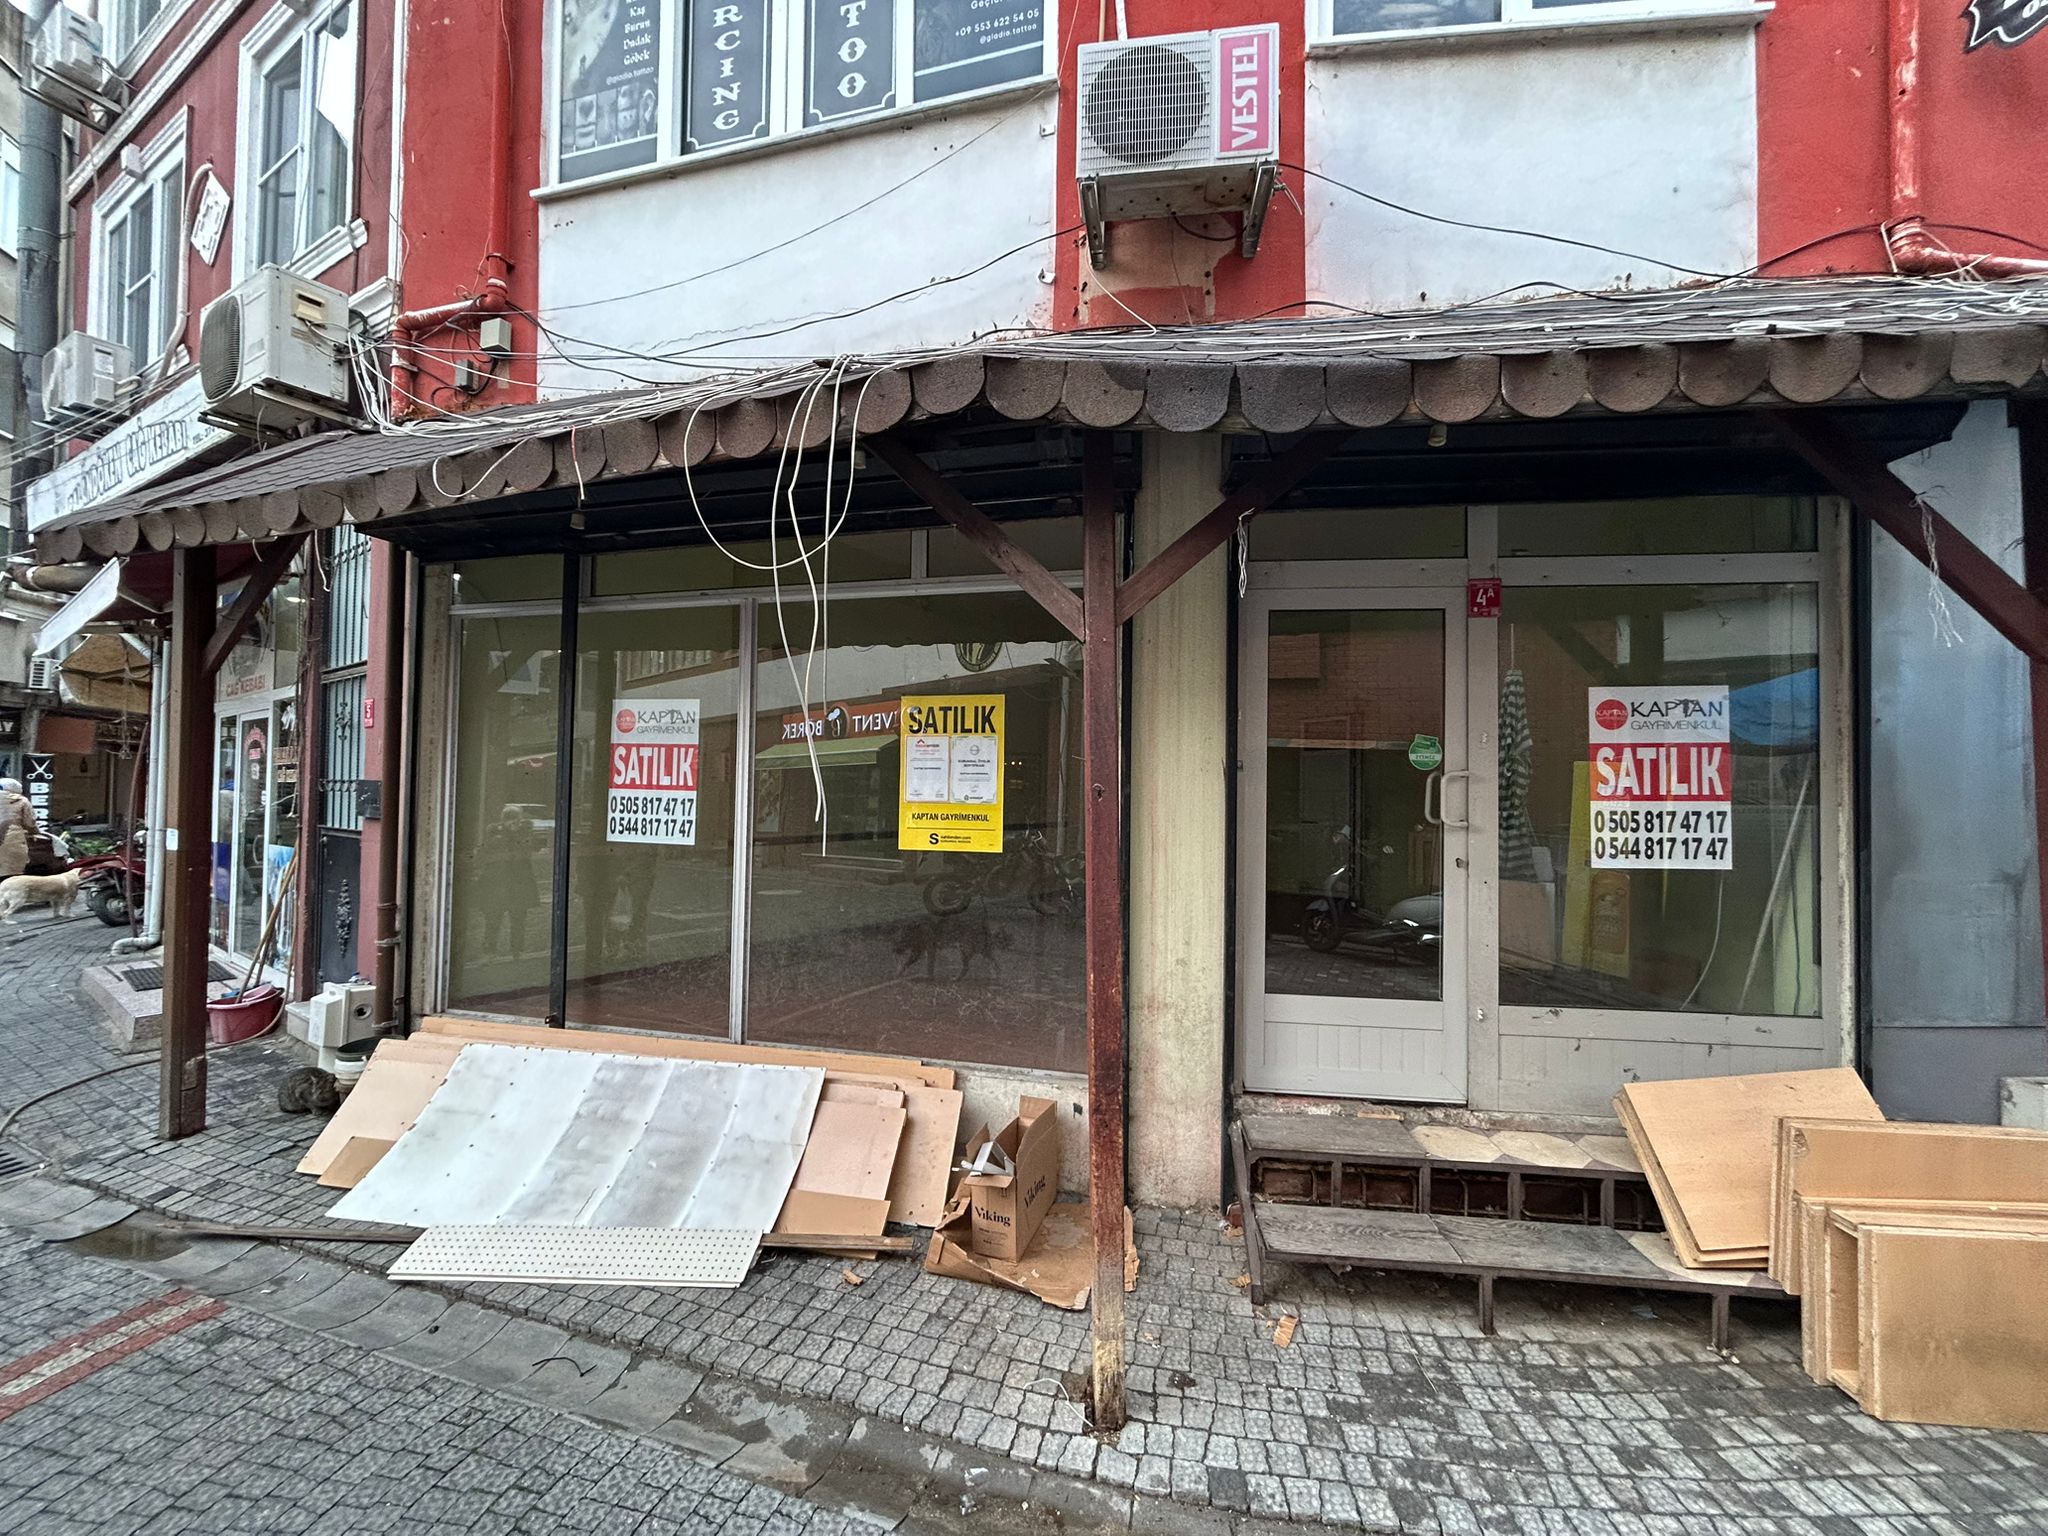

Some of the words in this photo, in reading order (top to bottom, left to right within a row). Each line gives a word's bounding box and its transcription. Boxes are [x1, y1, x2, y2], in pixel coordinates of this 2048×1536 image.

[624, 19, 650, 33] Burun
[974, 20, 991, 33] 553
[993, 16, 1010, 28] 622
[1012, 12, 1024, 23] 54
[1026, 8, 1039, 18] 05
[623, 33, 651, 49] Dudak
[980, 24, 1037, 44] @gladio.tattoo
[1231, 37, 1258, 149] VESTEL
[638, 708, 696, 725] KAPTAN
[1630, 699, 1723, 718] KAPTAN
[907, 705, 997, 734] SATILIK
[613, 746, 695, 787] SATILIK
[1596, 746, 1724, 796] SATILIK
[610, 796, 618, 814] 0
[619, 796, 640, 815] 505
[641, 797, 662, 816] 817
[664, 797, 678, 816] 47
[680, 798, 695, 817] 17
[912, 812, 939, 821] KAPTAN
[940, 812, 990, 822] GAYRİMENKUL
[609, 816, 617, 835] 0
[618, 816, 639, 835] 544
[640, 817, 661, 836] 817
[664, 818, 677, 837] 17
[679, 819, 693, 838] 47
[1594, 810, 1605, 833] 0
[1608, 810, 1640, 833] 505
[1644, 810, 1677, 833] 817
[1680, 810, 1702, 833] 47
[1705, 811, 1728, 833] 17
[1594, 836, 1606, 859] 0
[1608, 836, 1640, 860] 544
[1644, 836, 1677, 860] 817
[1681, 837, 1703, 860] 17
[1705, 837, 1728, 860] 47
[974, 1206, 1011, 1227] Viking
